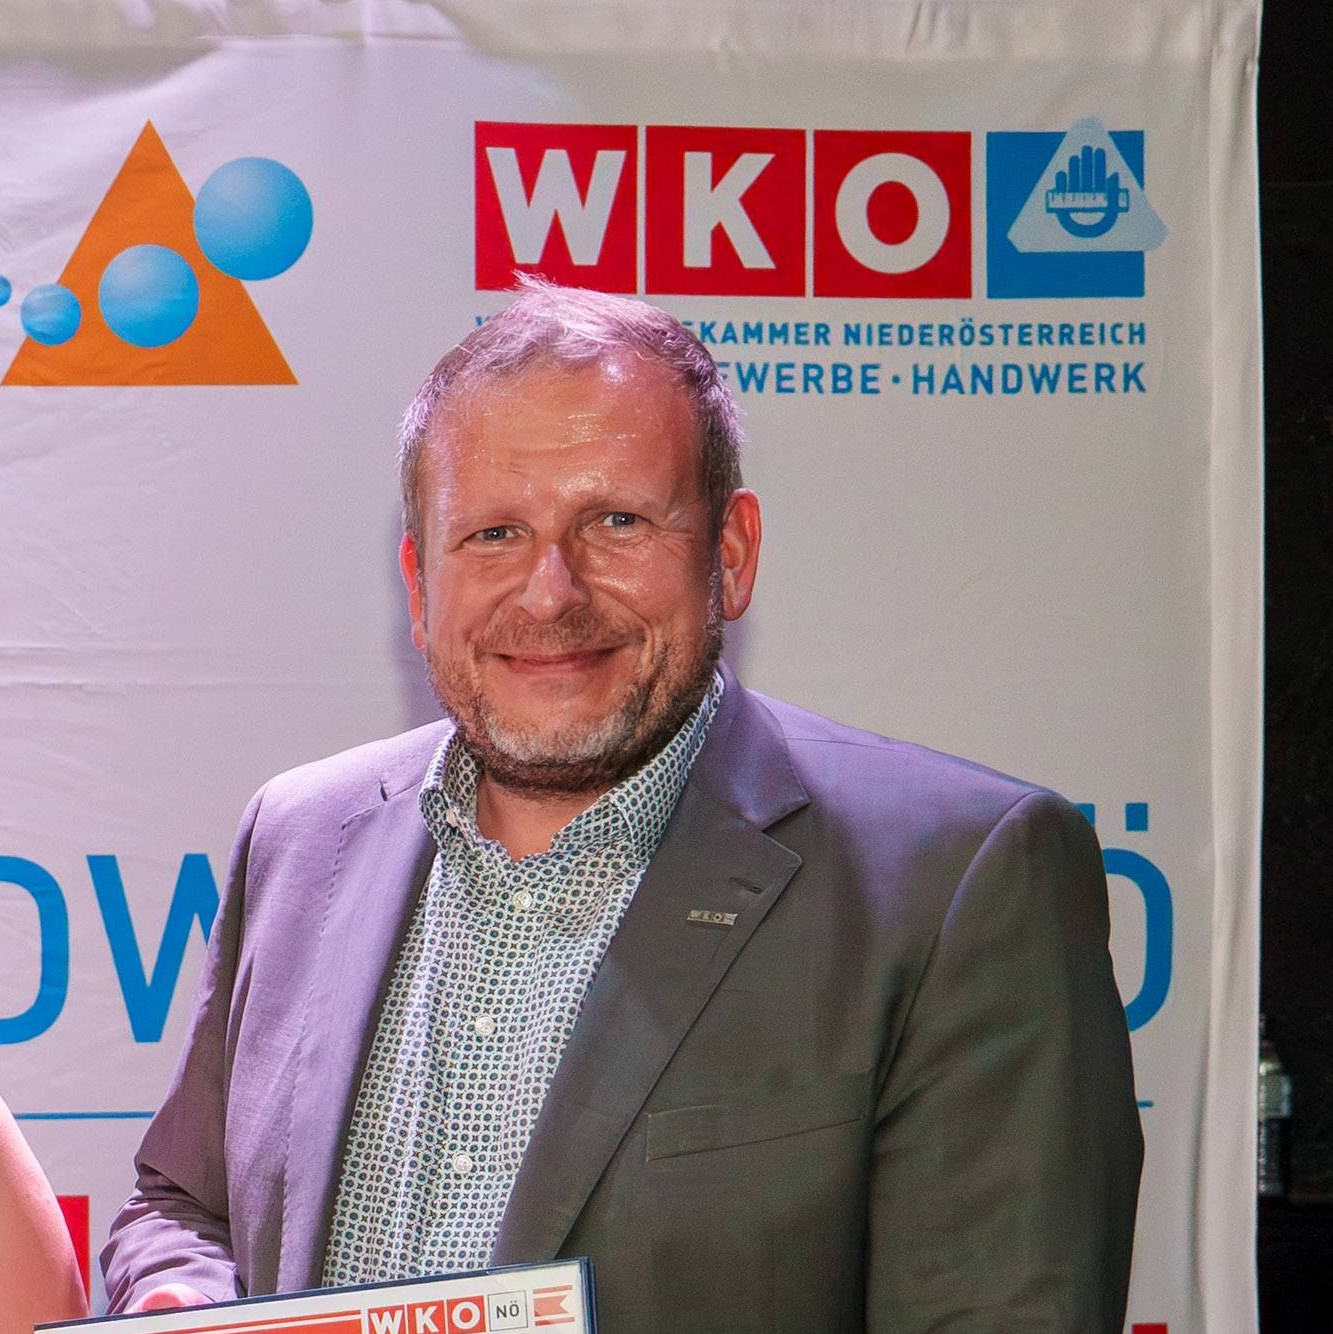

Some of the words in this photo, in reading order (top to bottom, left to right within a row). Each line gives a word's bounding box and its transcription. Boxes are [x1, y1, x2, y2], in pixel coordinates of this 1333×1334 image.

[485, 146, 951, 275] WKO
[682, 320, 831, 346] KAMMER
[843, 317, 1147, 346] NIEDERÖSTERREICH
[911, 361, 1148, 395] HANDWERK
[495, 1299, 521, 1320] NÖ
